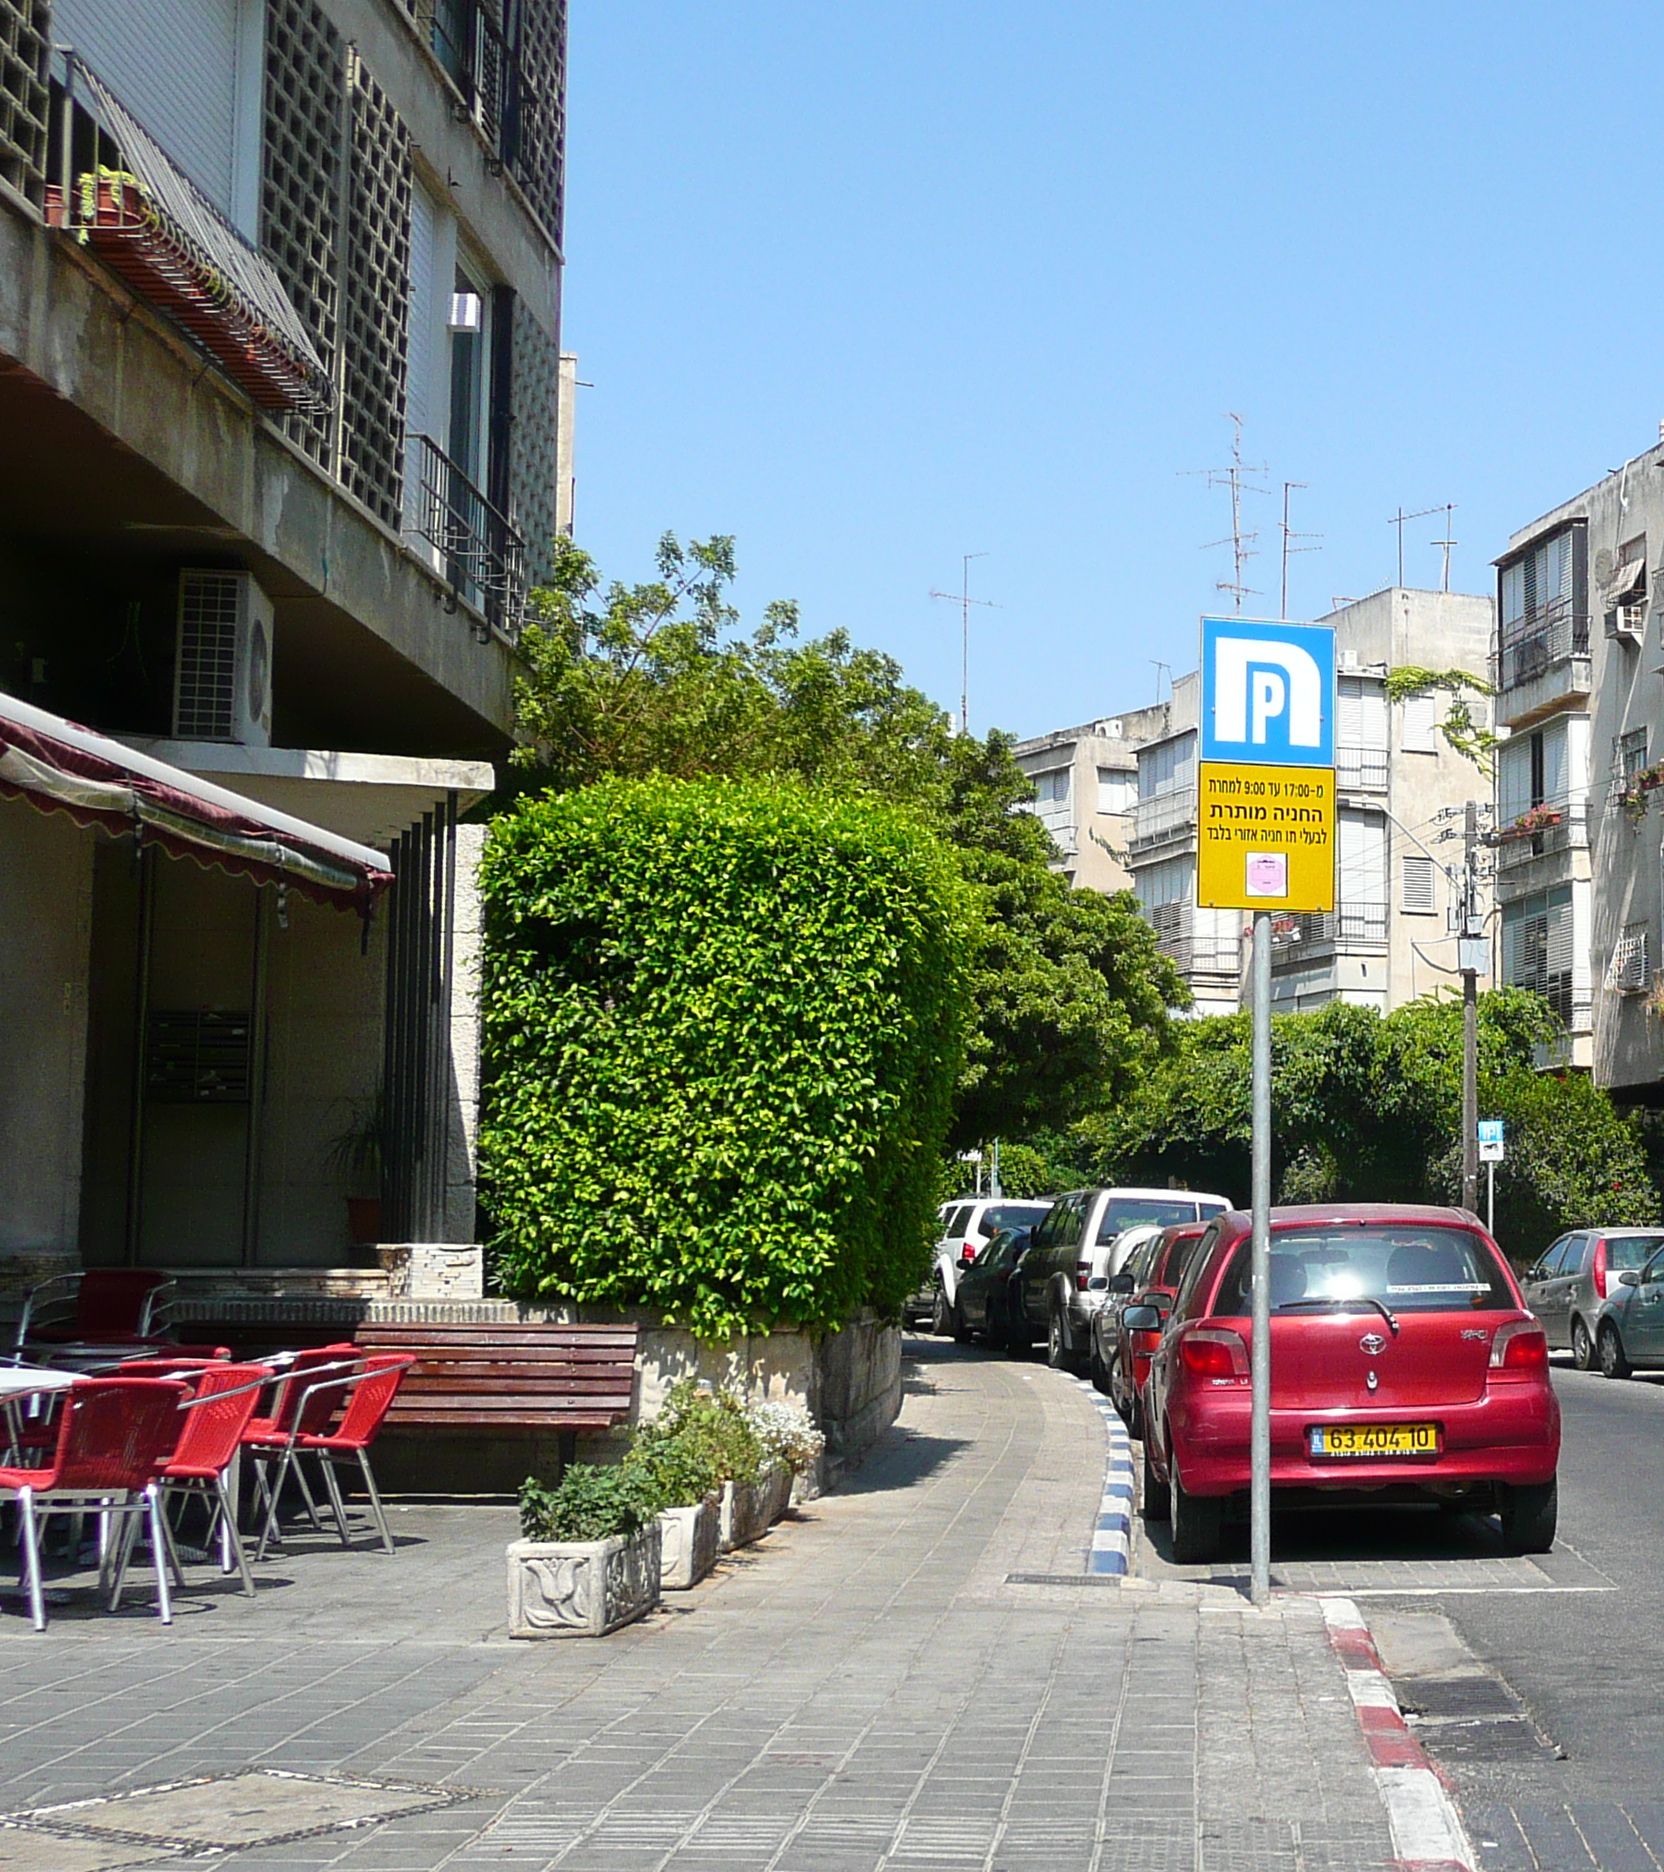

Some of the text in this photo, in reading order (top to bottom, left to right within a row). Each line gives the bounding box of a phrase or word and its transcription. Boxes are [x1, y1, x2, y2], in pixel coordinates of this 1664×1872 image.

[1209, 776, 1241, 793] למחרת
[1244, 781, 1265, 795] 9:00
[1268, 782, 1281, 797] עד
[1210, 804, 1323, 822] החניה מותרת
[1206, 824, 1327, 845] לבעלי תו חניה אזורי בלבד
